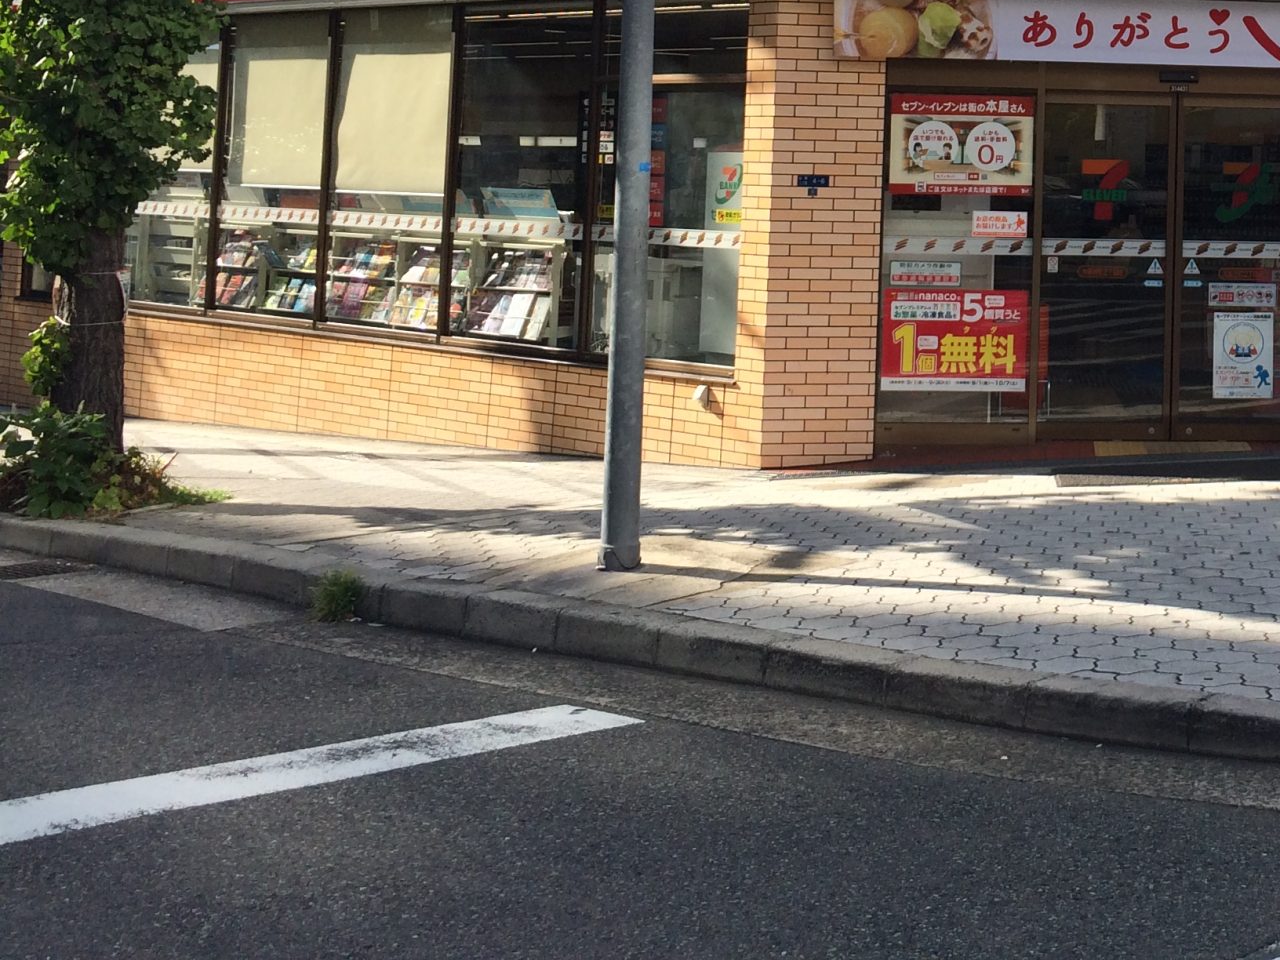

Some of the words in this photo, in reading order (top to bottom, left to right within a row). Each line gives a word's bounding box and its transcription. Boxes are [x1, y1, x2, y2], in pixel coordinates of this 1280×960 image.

[1022, 9, 1232, 55] ありがとう
[919, 292, 957, 302] nanaco
